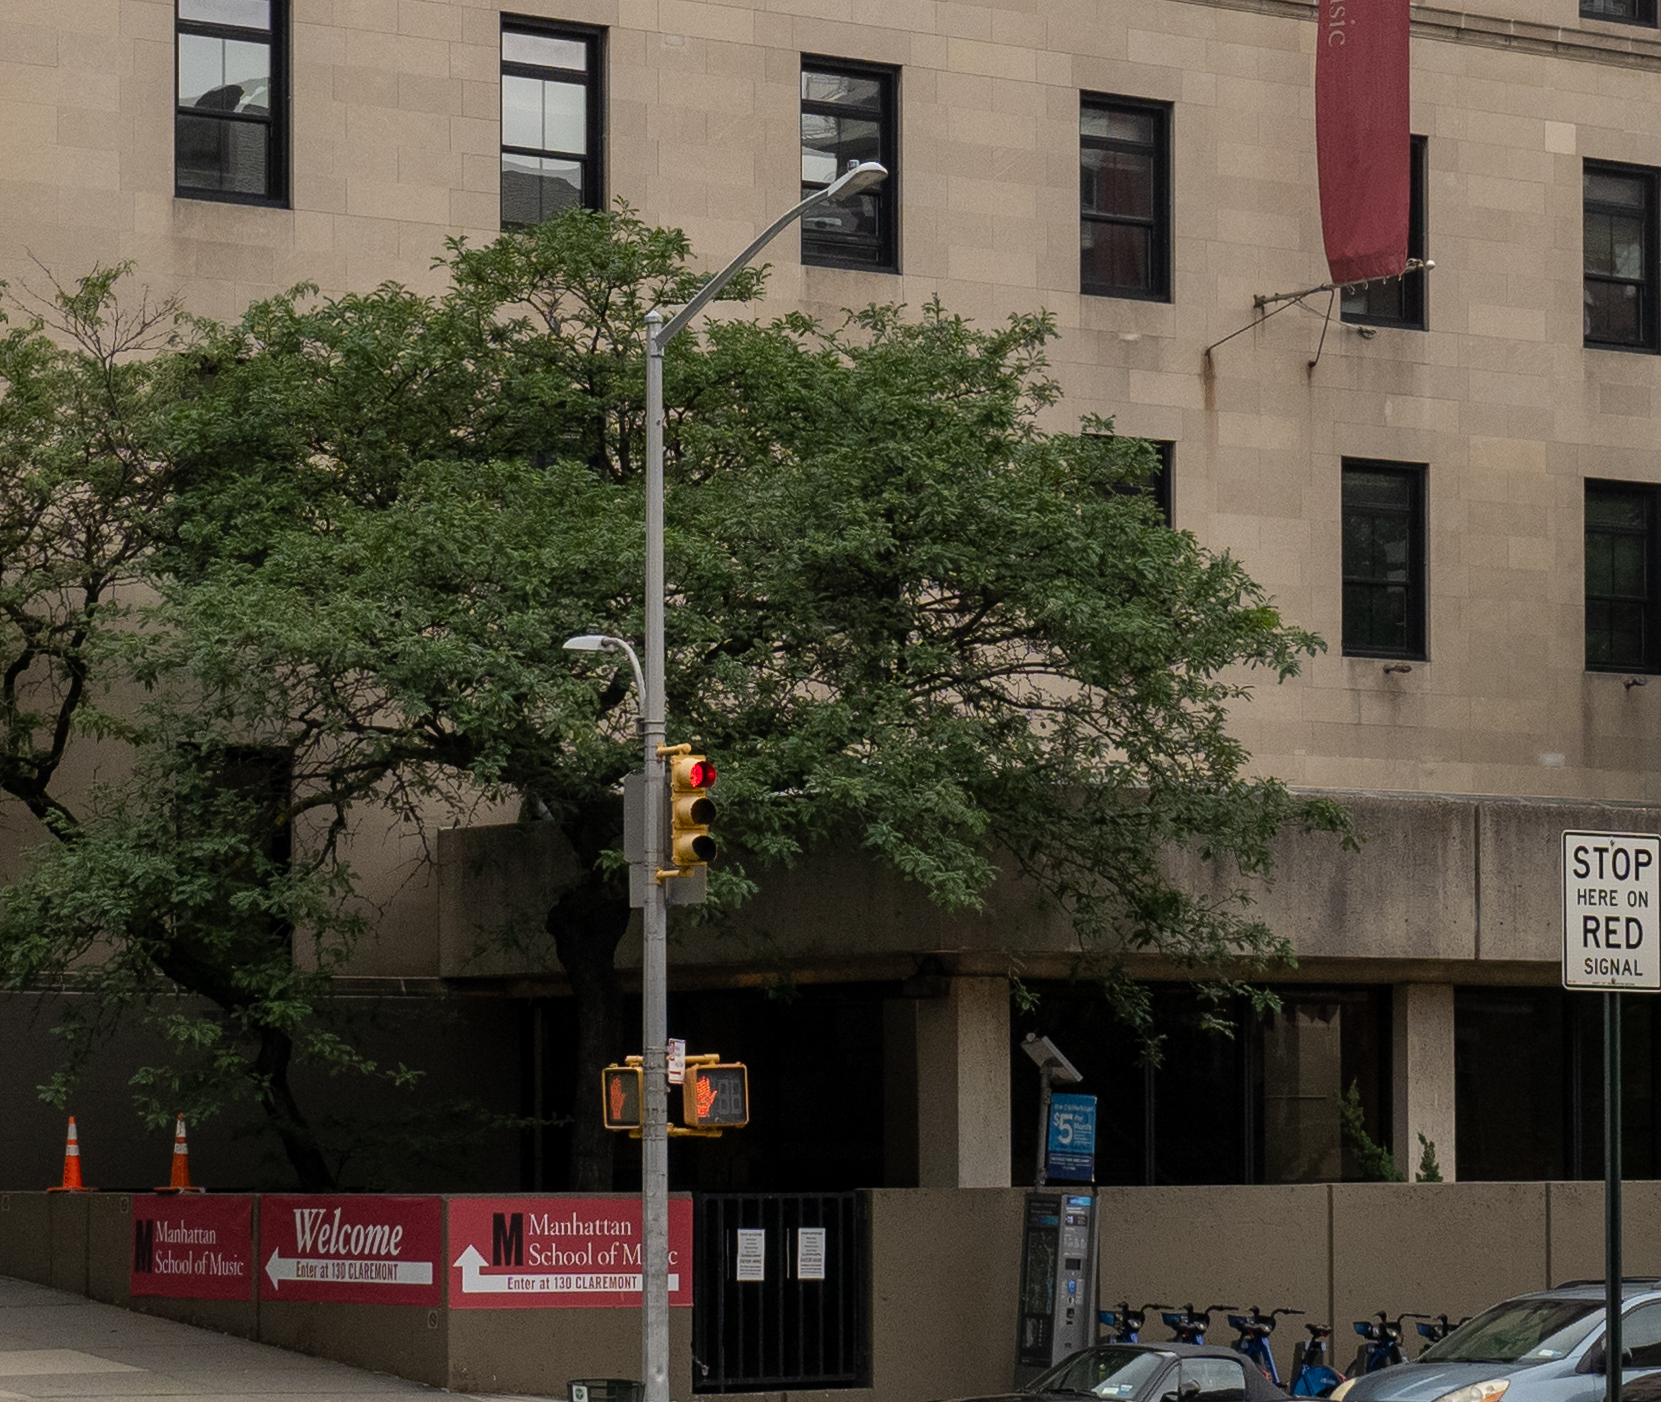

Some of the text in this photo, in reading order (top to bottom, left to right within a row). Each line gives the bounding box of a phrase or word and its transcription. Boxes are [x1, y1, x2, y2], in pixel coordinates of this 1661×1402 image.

[1573, 845, 1653, 881] STOP
[1577, 888, 1648, 908] HERE ON
[1582, 915, 1644, 950] RED
[1584, 958, 1643, 976] SIGNAL
[1053, 1112, 1073, 1144] $5
[155, 1219, 216, 1244] Manhattan
[293, 1207, 403, 1256] Welcome
[528, 1212, 632, 1236] Manhattan
[155, 1250, 244, 1276] School of Music
[528, 1241, 593, 1266] School
[597, 1241, 620, 1265] of
[296, 1260, 399, 1281] Enter at 130 CLAREMONT
[507, 1276, 637, 1290] Enter at 130 CLAREMONT
